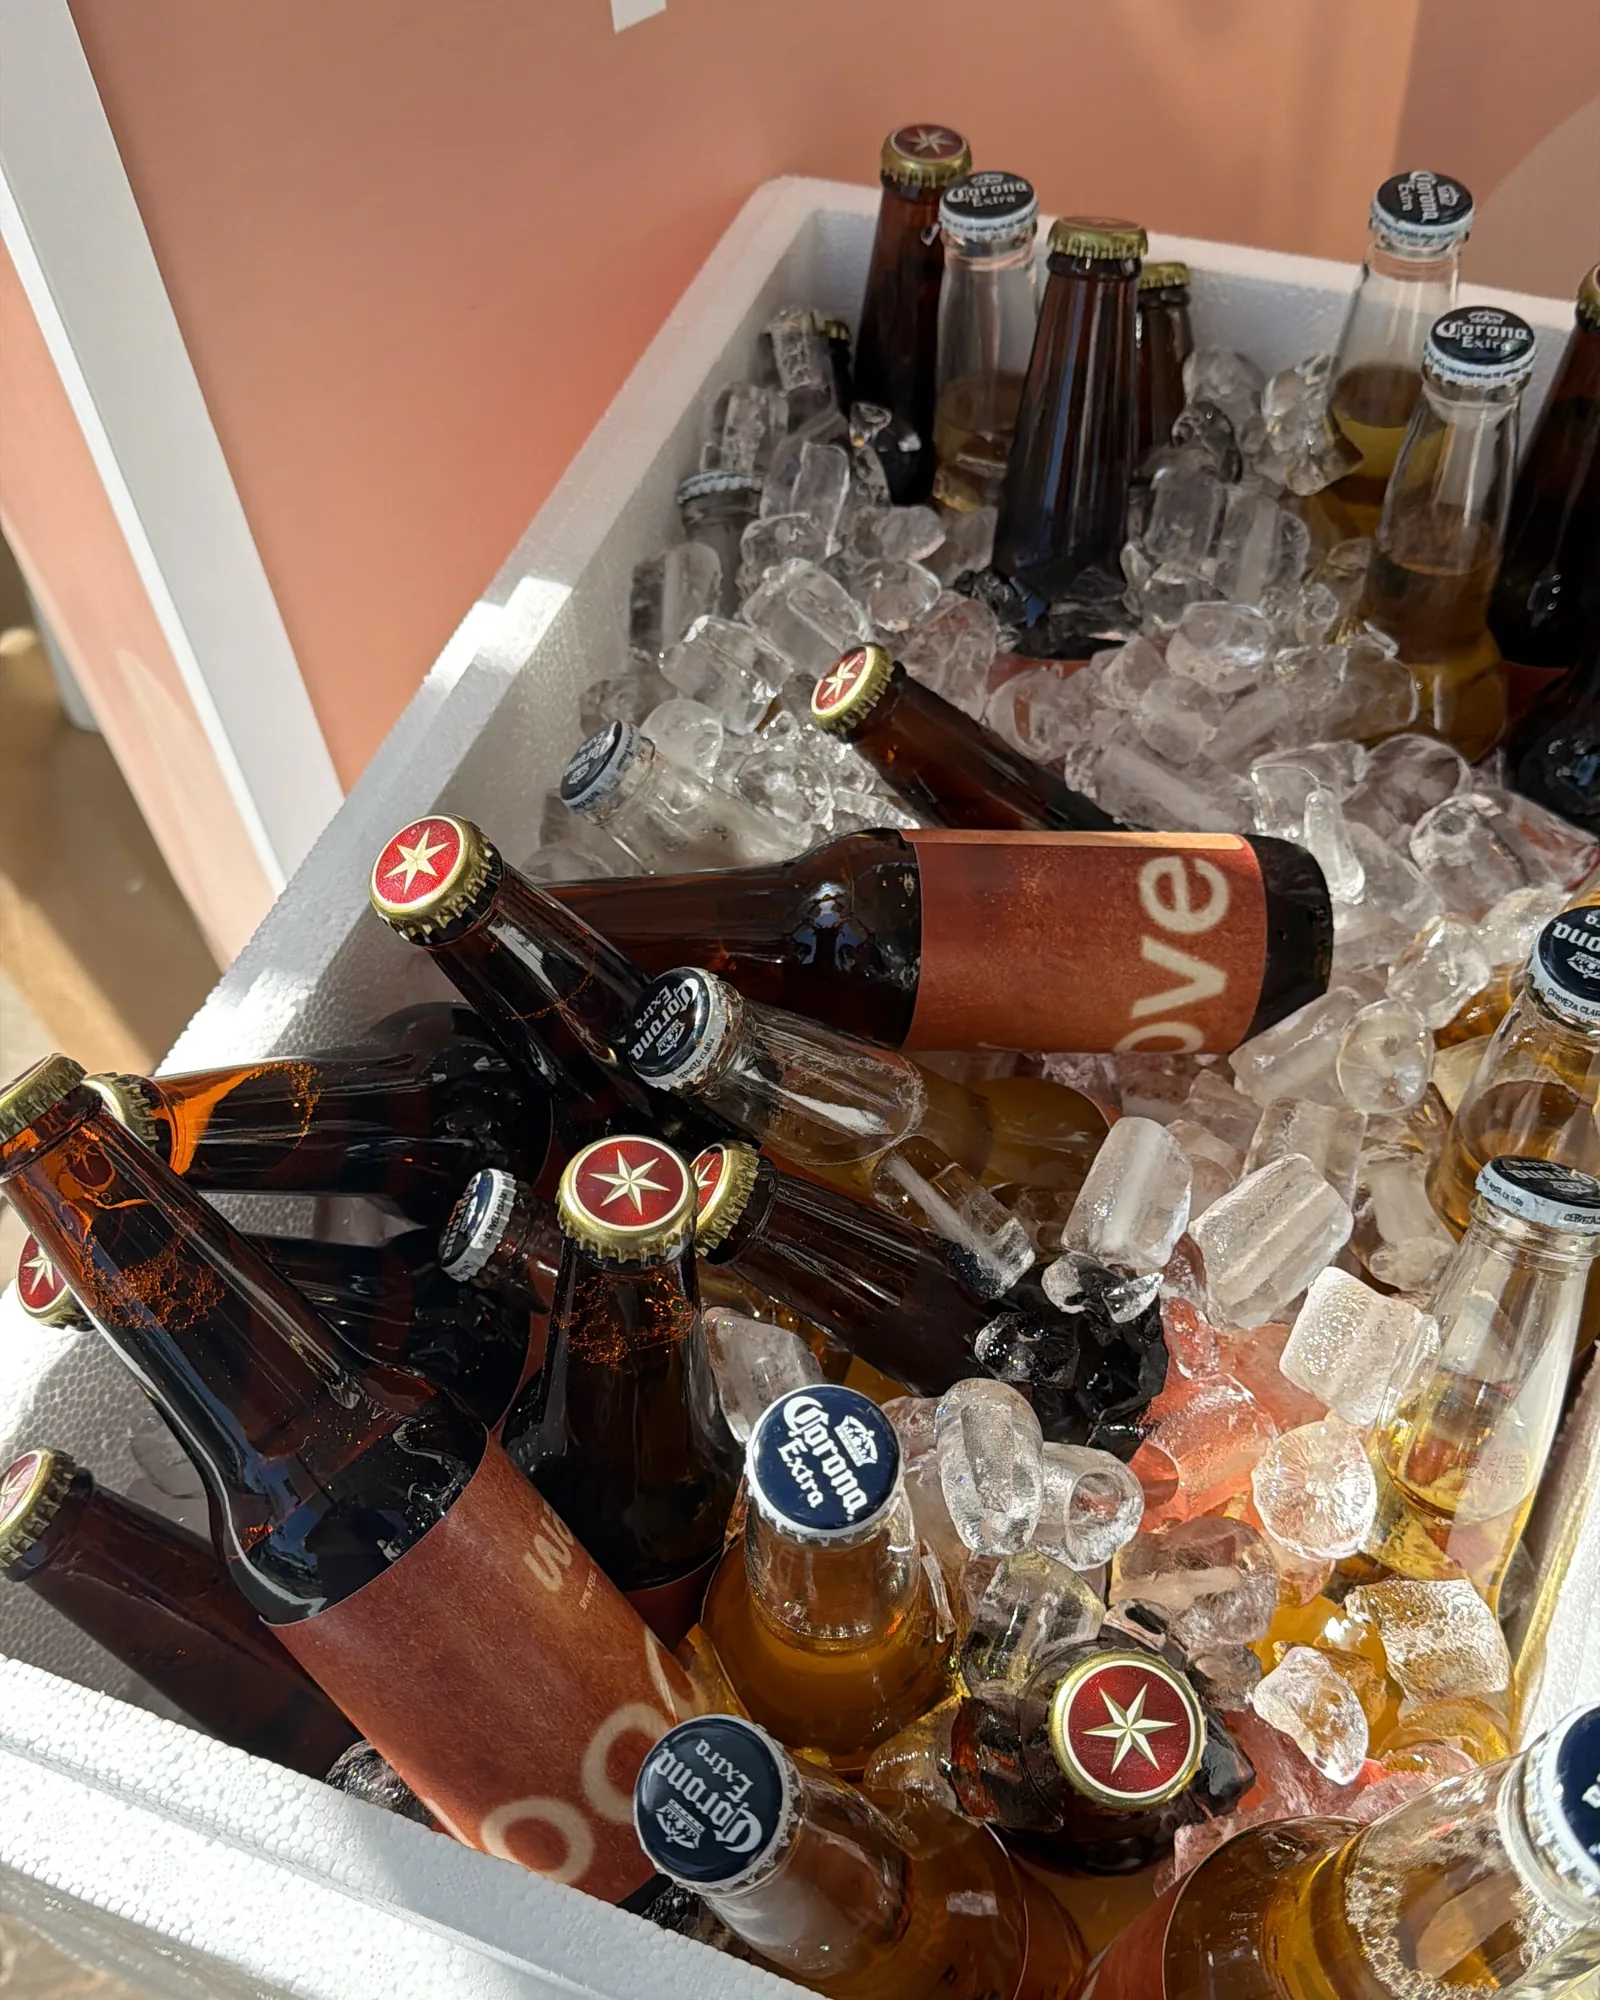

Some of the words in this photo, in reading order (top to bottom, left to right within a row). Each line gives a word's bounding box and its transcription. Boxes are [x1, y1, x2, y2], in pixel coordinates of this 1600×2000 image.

[946, 182, 1028, 203] Corona
[972, 194, 1016, 208] Extra
[1398, 183, 1414, 211] Extra
[1410, 171, 1438, 222] Corona
[1436, 319, 1529, 340] Corona
[1461, 336, 1511, 352] Extra
[634, 985, 674, 1030] Extra
[1547, 987, 1579, 1012] CERVEZA
[630, 977, 699, 1061] Corona
[700, 1038, 716, 1060] CLARA
[777, 1437, 824, 1509] Extra
[783, 1395, 868, 1516] Corona
[695, 1739, 754, 1803] Extra
[654, 1745, 763, 1853] Corona
